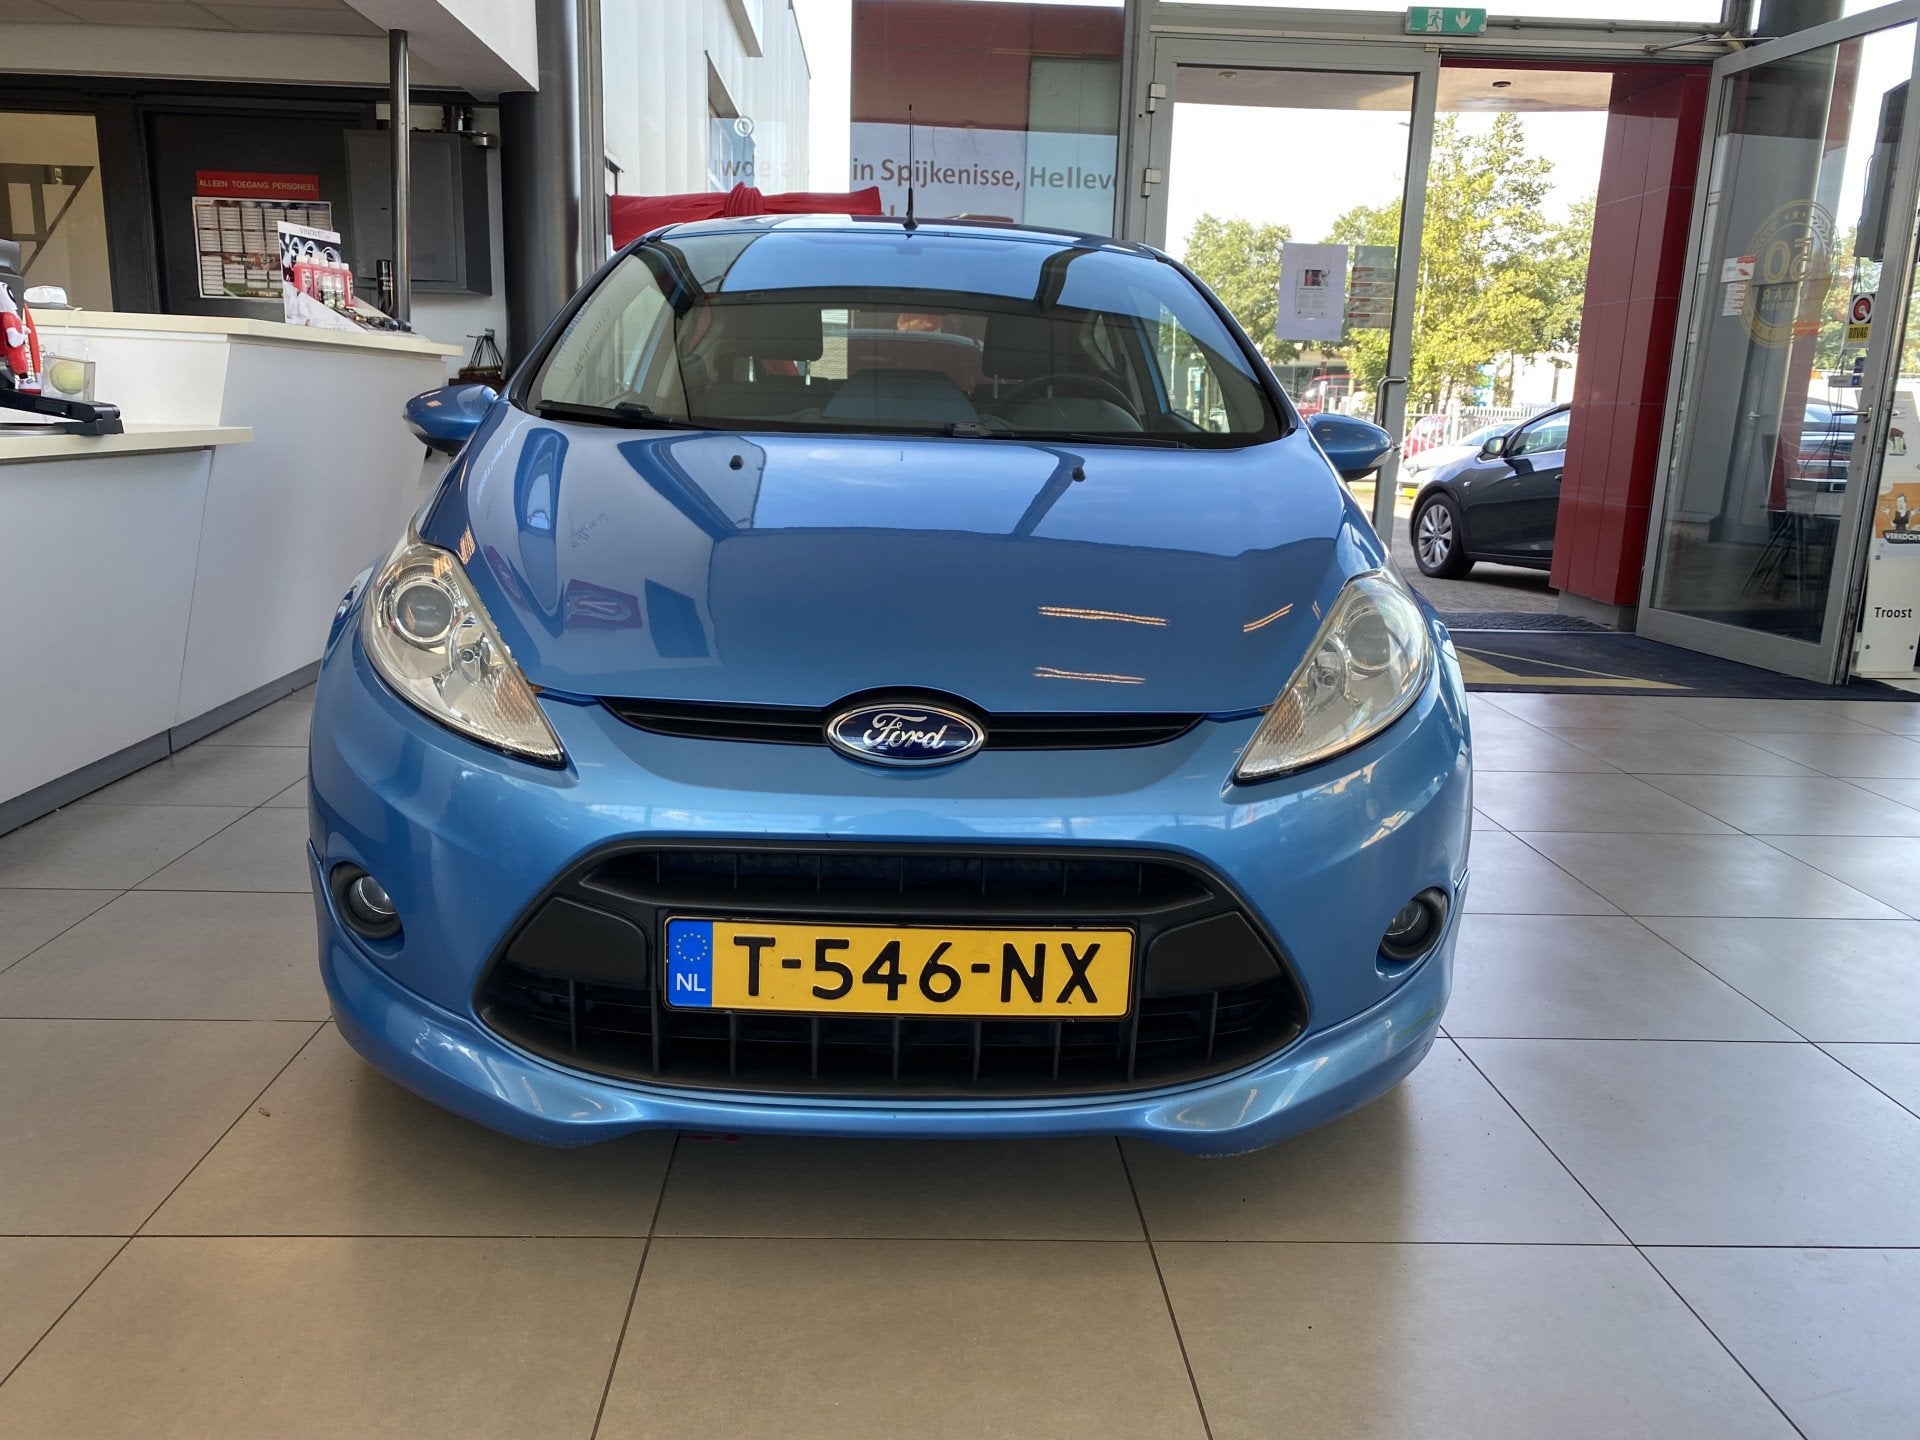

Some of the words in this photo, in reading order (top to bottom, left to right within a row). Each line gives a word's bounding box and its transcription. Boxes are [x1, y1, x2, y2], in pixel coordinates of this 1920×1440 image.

[853, 158, 875, 181] in
[880, 158, 1021, 192] Spijkenisse,
[198, 179, 228, 188] ALLEEN
[232, 181, 270, 190] TOEGANG
[272, 182, 317, 192] PERSONEEL
[1848, 326, 1869, 339] BOVAG
[1874, 606, 1913, 619] Troost
[862, 712, 948, 750] Ford
[733, 935, 1101, 1004] T-546-NX
[676, 973, 706, 993] NL
